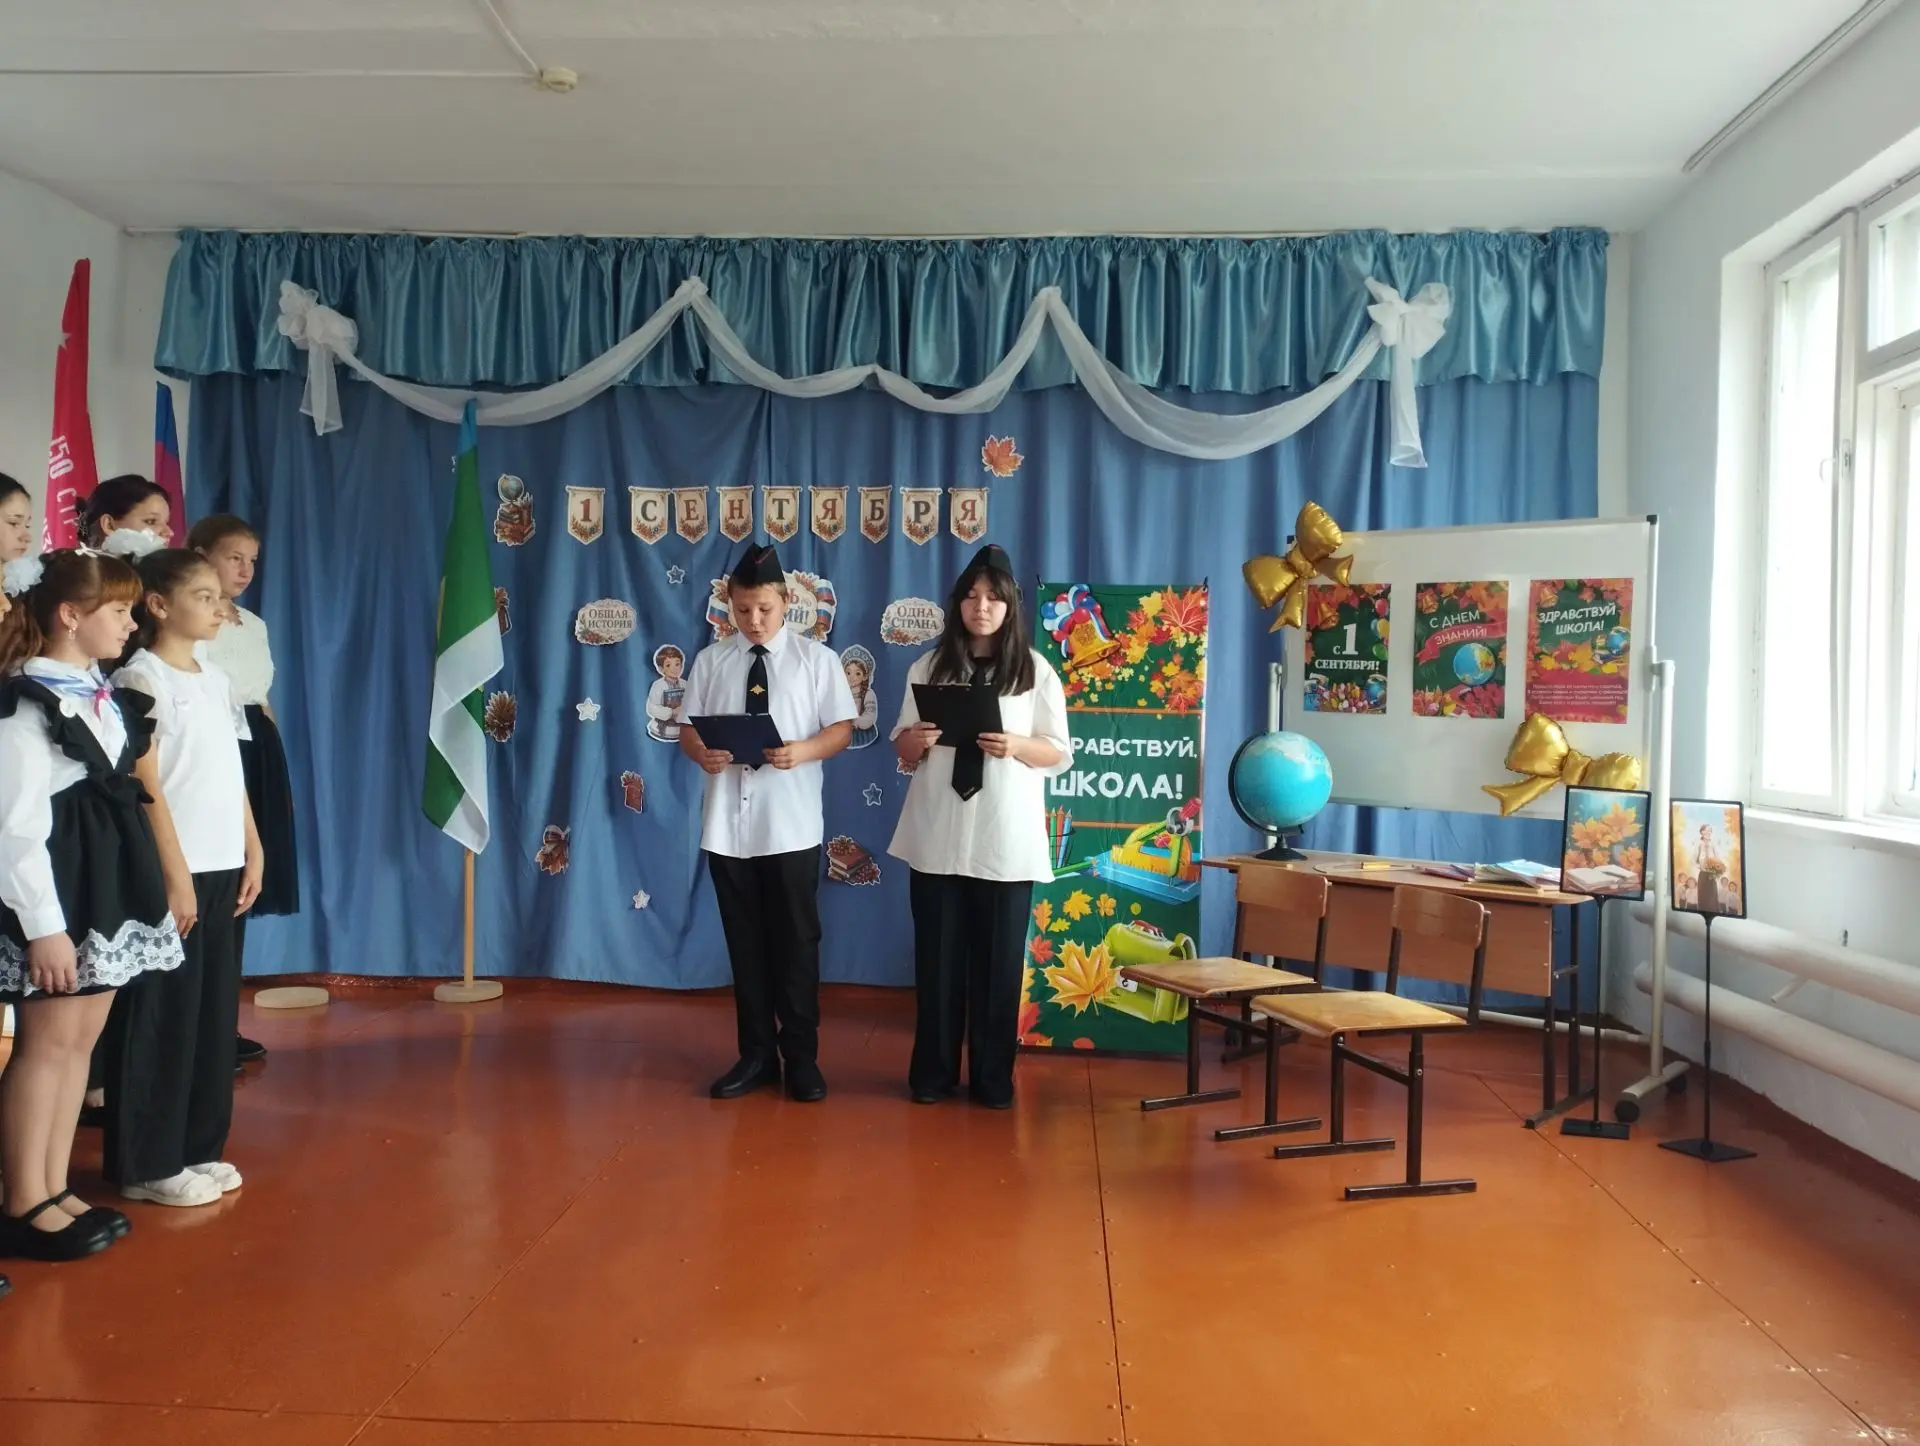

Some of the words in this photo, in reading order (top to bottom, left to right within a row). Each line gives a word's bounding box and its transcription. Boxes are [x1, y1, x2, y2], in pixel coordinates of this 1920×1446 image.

[49, 435, 74, 480] 150
[580, 498, 592, 522] 1
[640, 497, 978, 524] СЕНТЯБРЯ
[589, 608, 628, 619] ОБЩАЯ
[896, 605, 936, 618] ОДНА
[1441, 609, 1480, 629] ДНЕМ
[588, 618, 633, 629] ИСТОРИЯ
[891, 616, 938, 630] СТРАНА
[1555, 620, 1605, 635] ШКОЛА!
[1341, 623, 1359, 656] 1
[1435, 625, 1487, 645] ЗНАНИЙ!
[1315, 659, 1380, 671] СЕНТЯБРЯ!
[1070, 736, 1198, 758] РАВСТВУЙ,
[1050, 770, 1183, 800] ШКОЛА!
